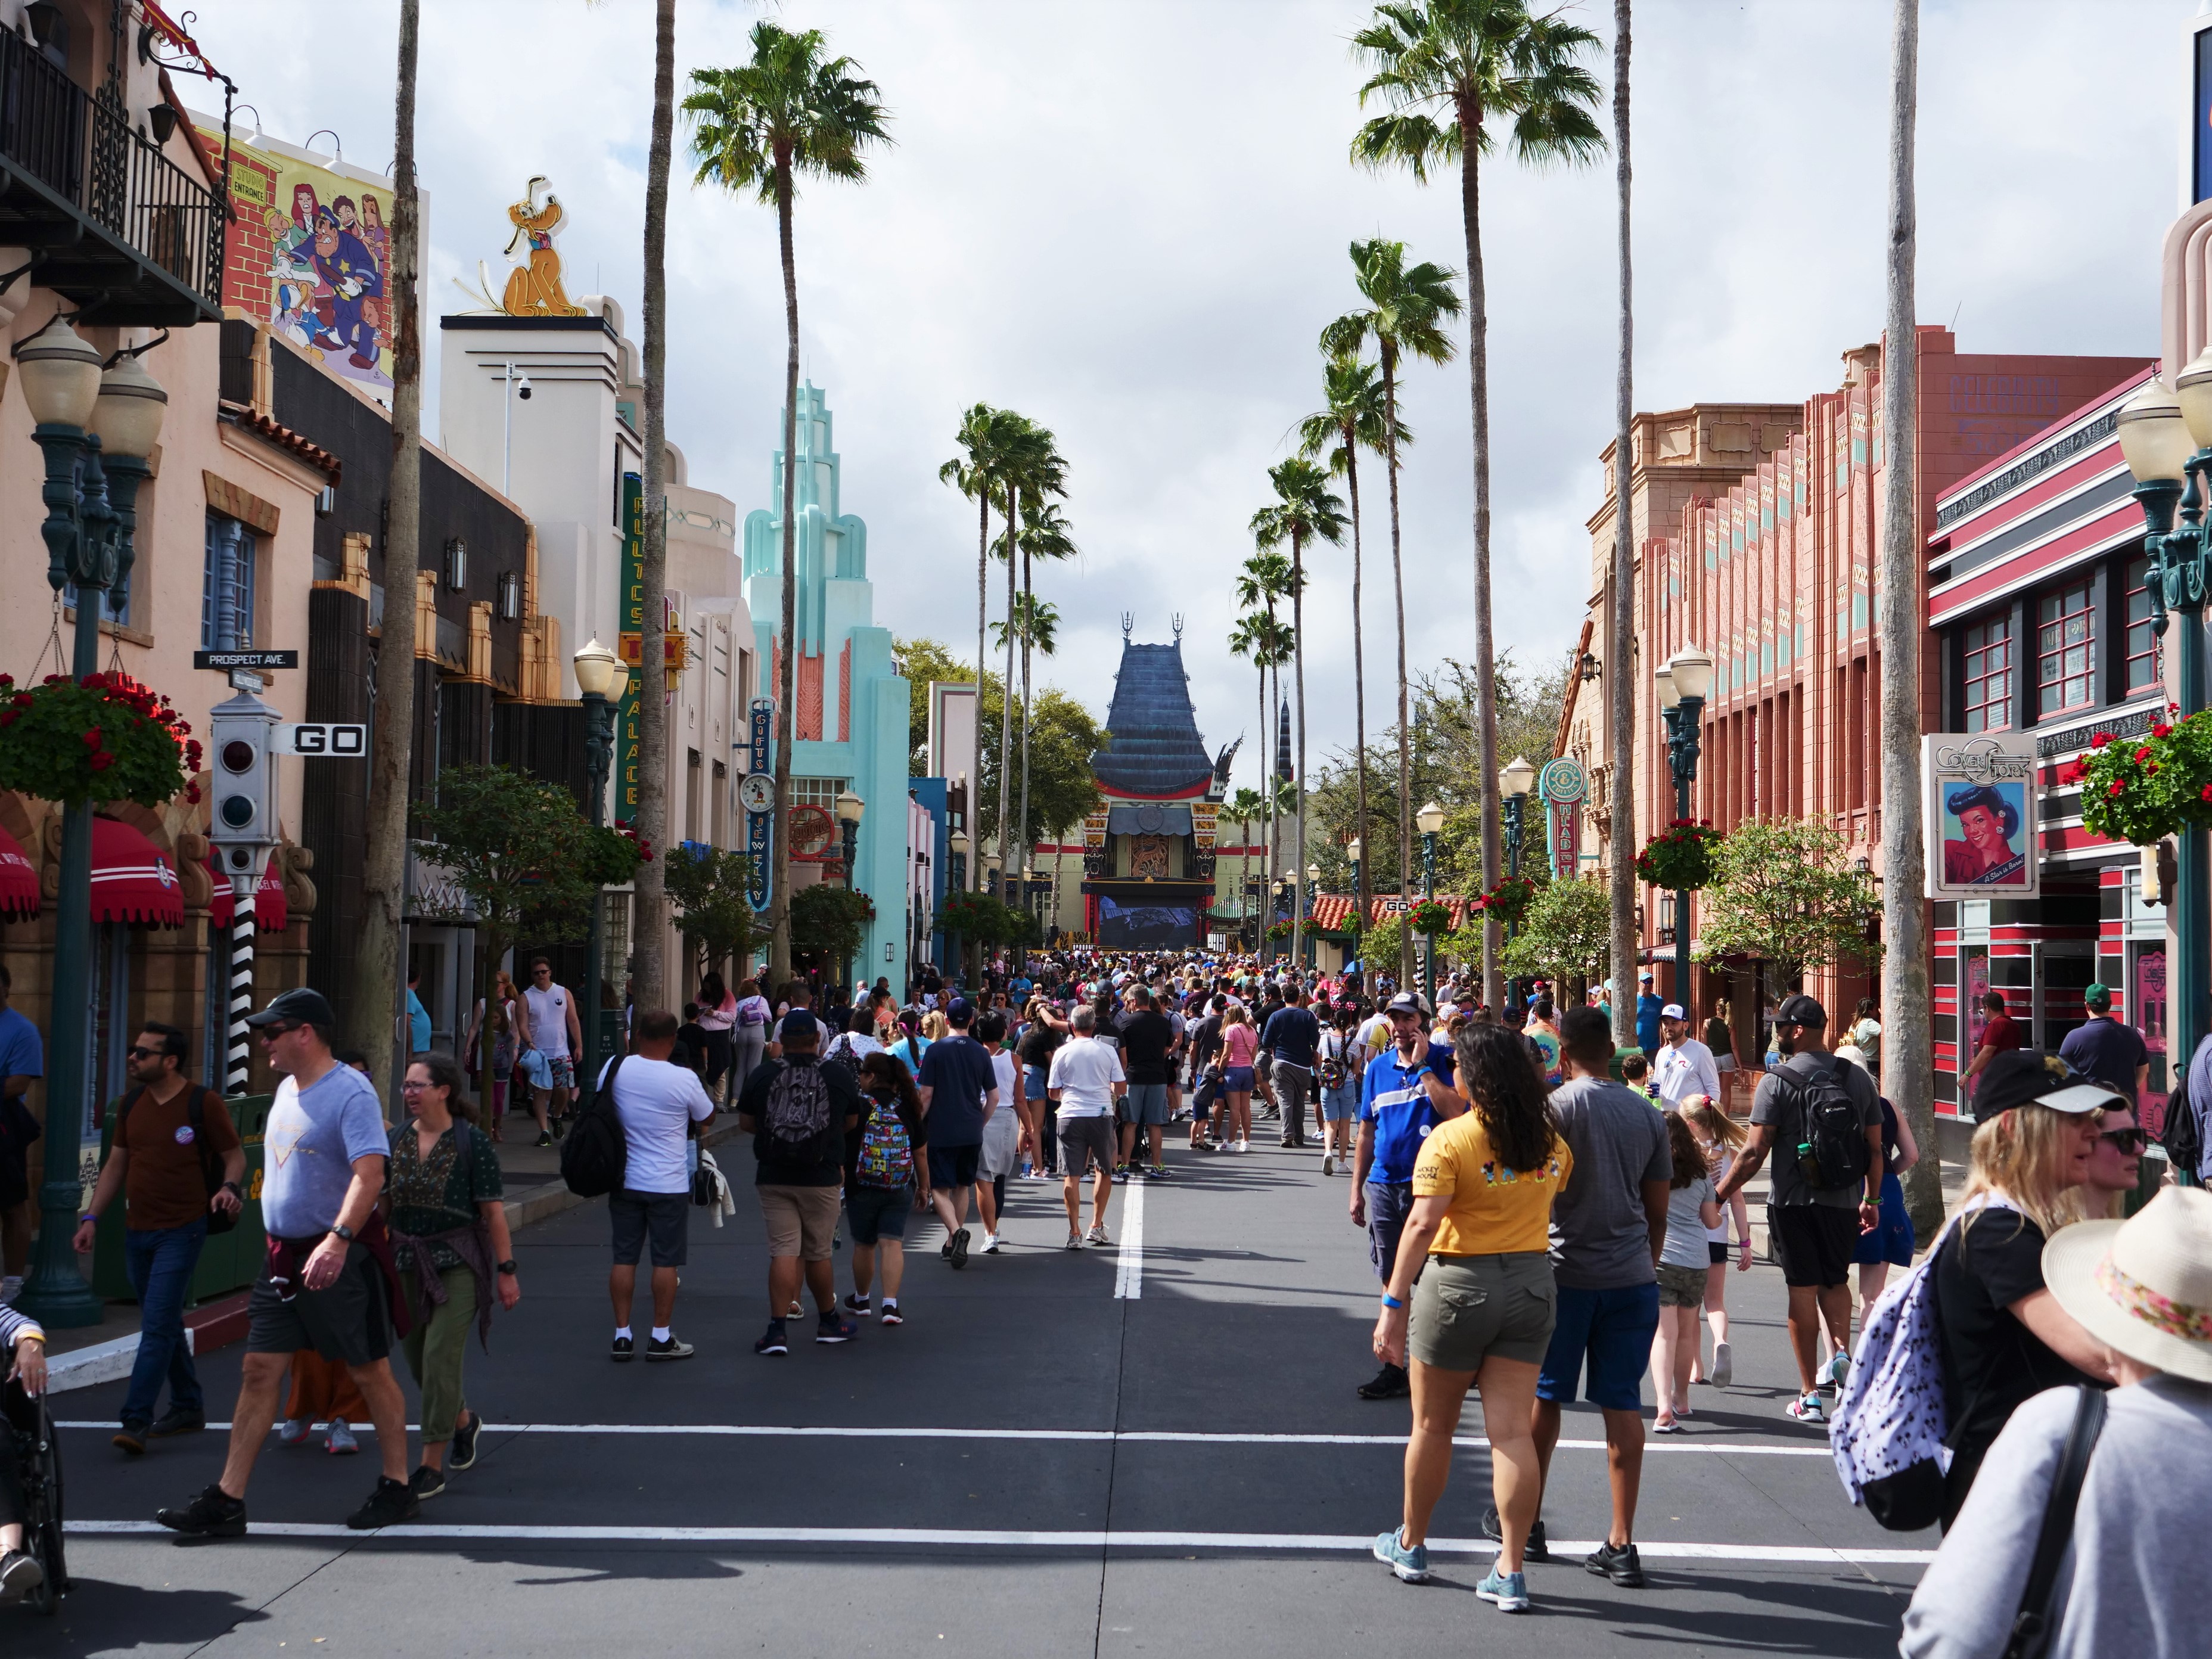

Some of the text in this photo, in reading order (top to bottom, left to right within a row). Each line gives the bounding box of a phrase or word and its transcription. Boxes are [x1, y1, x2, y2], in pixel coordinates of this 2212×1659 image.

[237, 168, 265, 189] STUDIO
[234, 181, 264, 202] ENTRANCE
[1949, 376, 2059, 414] CELEBRITY
[209, 655, 286, 664] PROSPECT AVE.
[627, 639, 678, 659] TY
[295, 726, 362, 754] GO
[755, 715, 766, 770] GIFTS
[1552, 763, 1577, 775] ADRIAN
[1559, 773, 1570, 785] &
[1559, 804, 1571, 850] HEAD
[1990, 871, 2002, 880] Star
[2008, 856, 2024, 869] Born!
[1387, 902, 1408, 911] GO
